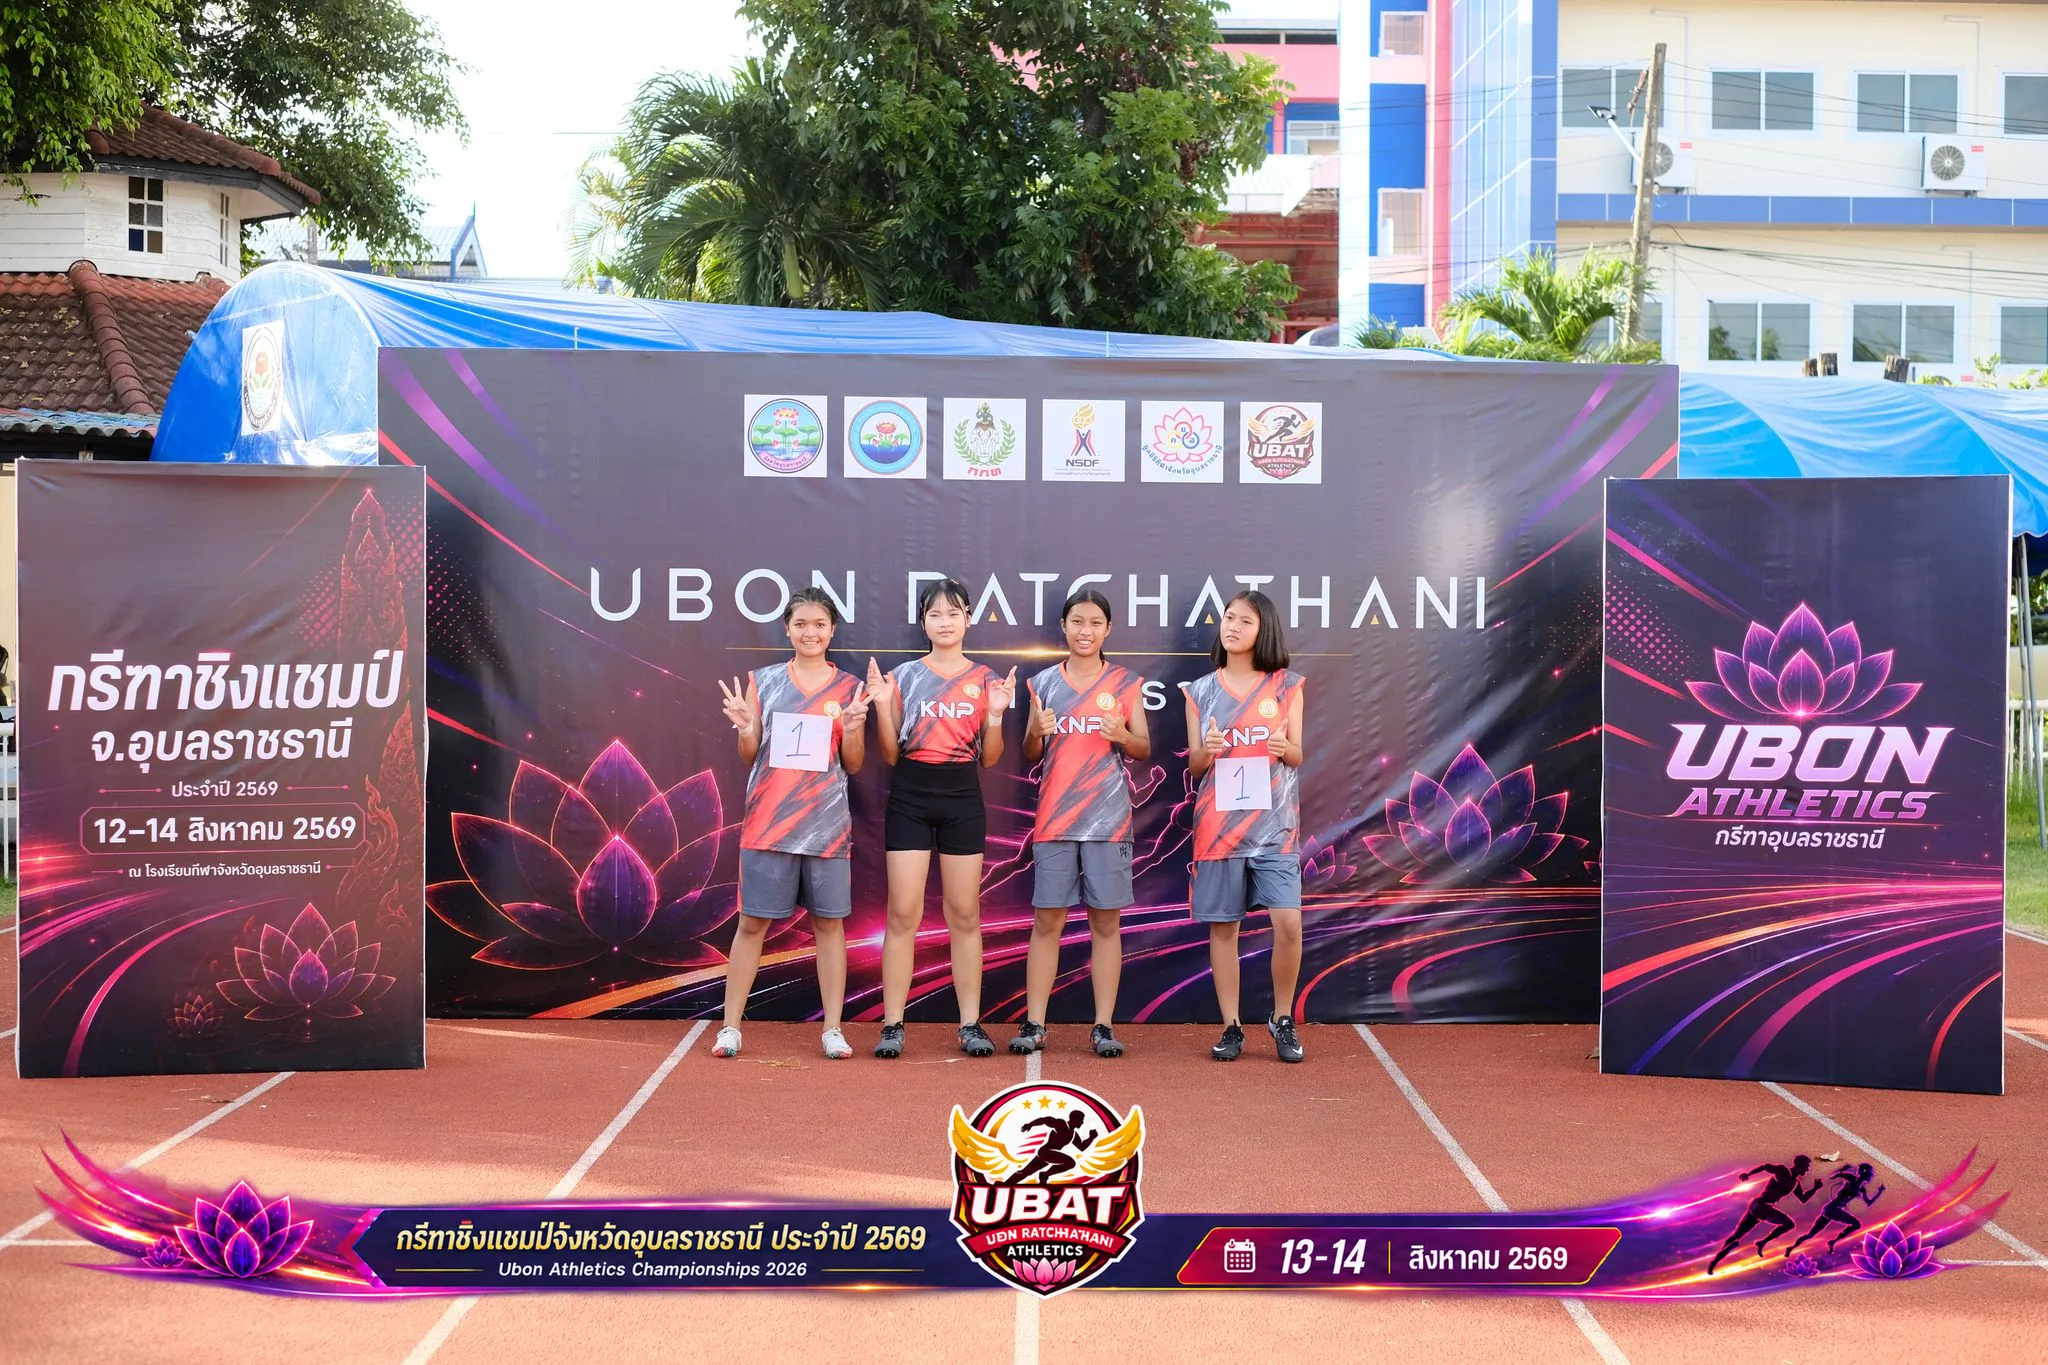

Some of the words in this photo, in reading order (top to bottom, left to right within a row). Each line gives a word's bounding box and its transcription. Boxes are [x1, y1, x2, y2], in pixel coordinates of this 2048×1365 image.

[1065, 459, 1100, 468] NSDF
[1253, 443, 1310, 458] UBAT
[590, 567, 856, 624] UBON
[47, 649, 405, 711] กรีฑาชิงแชมป์
[920, 700, 975, 719] KNP
[91, 717, 354, 774] จ.อุบลราชธานี
[785, 720, 811, 757] 1
[1666, 724, 1956, 784] UBON
[171, 780, 231, 799] ประจำปี
[236, 781, 279, 797] 2569
[1233, 765, 1251, 801] 1
[1665, 787, 1938, 820] ATHLETICS
[188, 816, 284, 843] สิงหาคม
[293, 815, 356, 840] 2569
[1714, 824, 1886, 854] กรีฑาอุบลราชธานี
[128, 866, 142, 878] ณ
[145, 861, 322, 879] โรงเรียนกีฬาจังหวัดอุบลราชธานี
